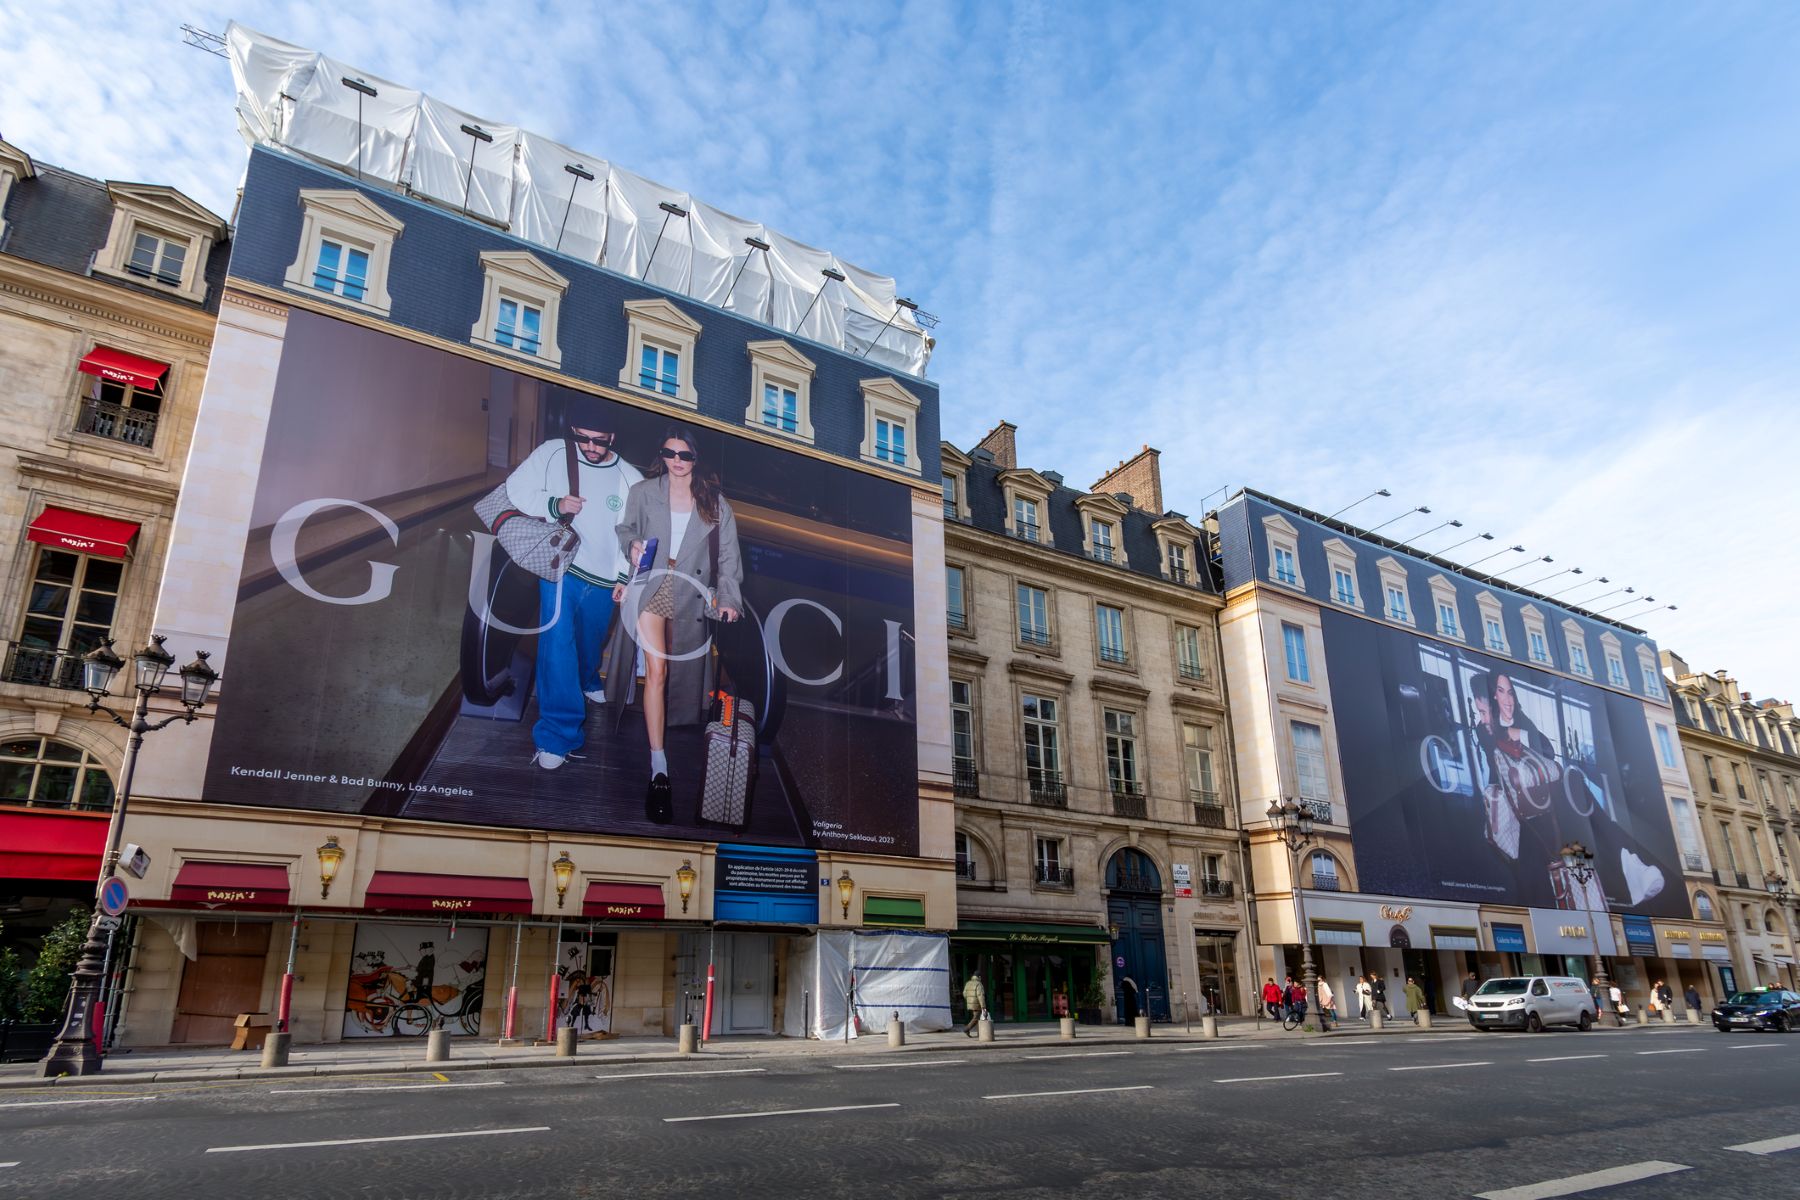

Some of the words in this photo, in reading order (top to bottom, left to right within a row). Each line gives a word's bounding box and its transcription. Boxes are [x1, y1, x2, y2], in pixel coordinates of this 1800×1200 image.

[269, 497, 904, 701] GUCCI
[231, 766, 281, 780] Kendall
[284, 771, 327, 783] Jenner
[329, 774, 338, 784] &
[341, 775, 364, 786] Bad
[367, 778, 406, 792] Bunny,
[408, 782, 428, 792] Los
[430, 784, 474, 797] Angeles
[812, 820, 842, 830] Valigeria
[821, 830, 848, 840] Anthony
